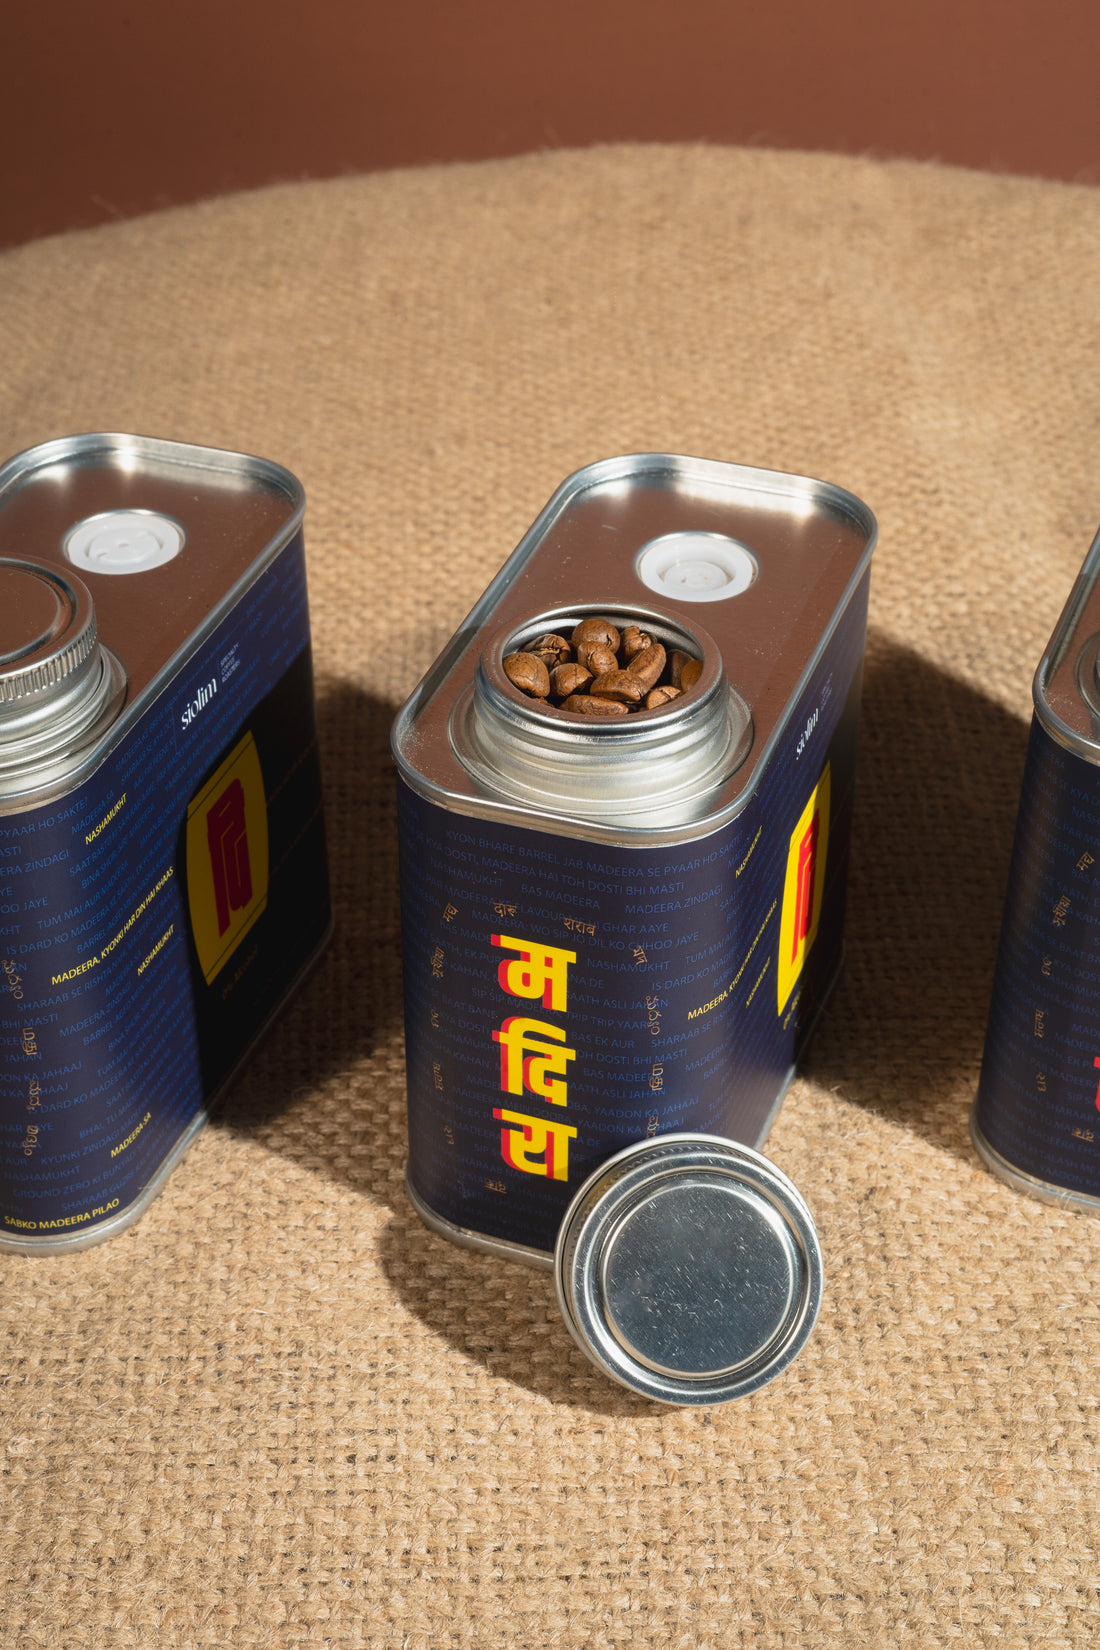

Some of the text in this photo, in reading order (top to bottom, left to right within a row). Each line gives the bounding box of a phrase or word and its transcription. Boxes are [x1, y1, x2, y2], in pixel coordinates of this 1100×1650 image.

[181, 677, 218, 731] siolim
[38, 816, 55, 830] HO
[85, 793, 127, 846] NASHAMUKHT
[25, 848, 70, 873] ZINDAGI
[519, 846, 560, 865] BARREL
[562, 857, 583, 870] JAB
[586, 861, 644, 878] MADEERA
[647, 867, 661, 878] SE
[664, 859, 700, 876] PYAAR
[702, 851, 718, 866] HO
[481, 855, 537, 878] MADEERA
[587, 880, 623, 897] DOSTI
[625, 886, 647, 896] BHI
[648, 881, 685, 896] MASTI
[24, 896, 49, 911] JAYE
[544, 889, 600, 910] MADEERA
[624, 883, 723, 914] MADEERA ZINDAGI
[37, 914, 62, 930] TUM
[64, 904, 84, 921] MAI
[51, 865, 174, 986] MADEERA, KYONKI HAR DIN HAI KHAAS
[563, 916, 596, 937] शराब
[639, 922, 669, 934] AAYE
[7, 945, 17, 955] IS
[20, 938, 52, 954] DARD
[54, 932, 69, 945] KO
[676, 931, 700, 946] JAYE
[71, 986, 83, 999] SE
[664, 974, 695, 990] DARD
[24, 1013, 59, 1028] MASTI
[4, 1197, 120, 1230] SABKO MADEERA PILAO
